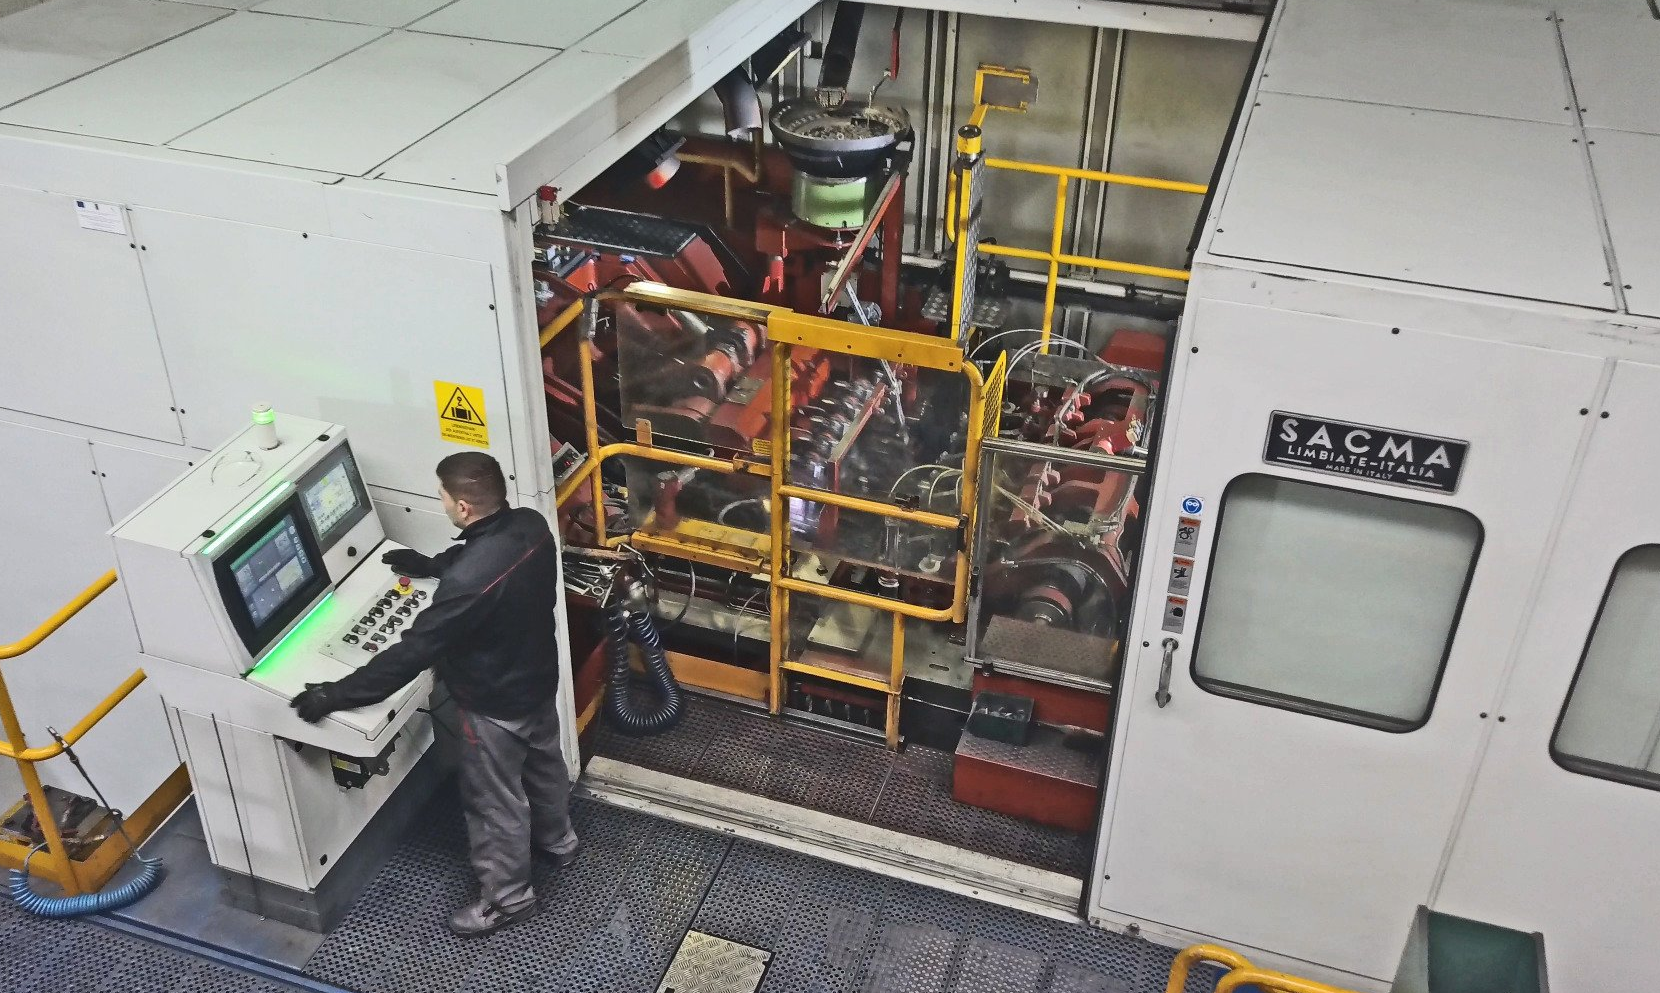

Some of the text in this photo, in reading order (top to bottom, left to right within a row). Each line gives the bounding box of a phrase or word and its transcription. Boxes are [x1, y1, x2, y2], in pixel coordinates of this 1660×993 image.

[1279, 418, 1451, 469] SACMA
[1326, 464, 1393, 480] MADE IN ITALY
